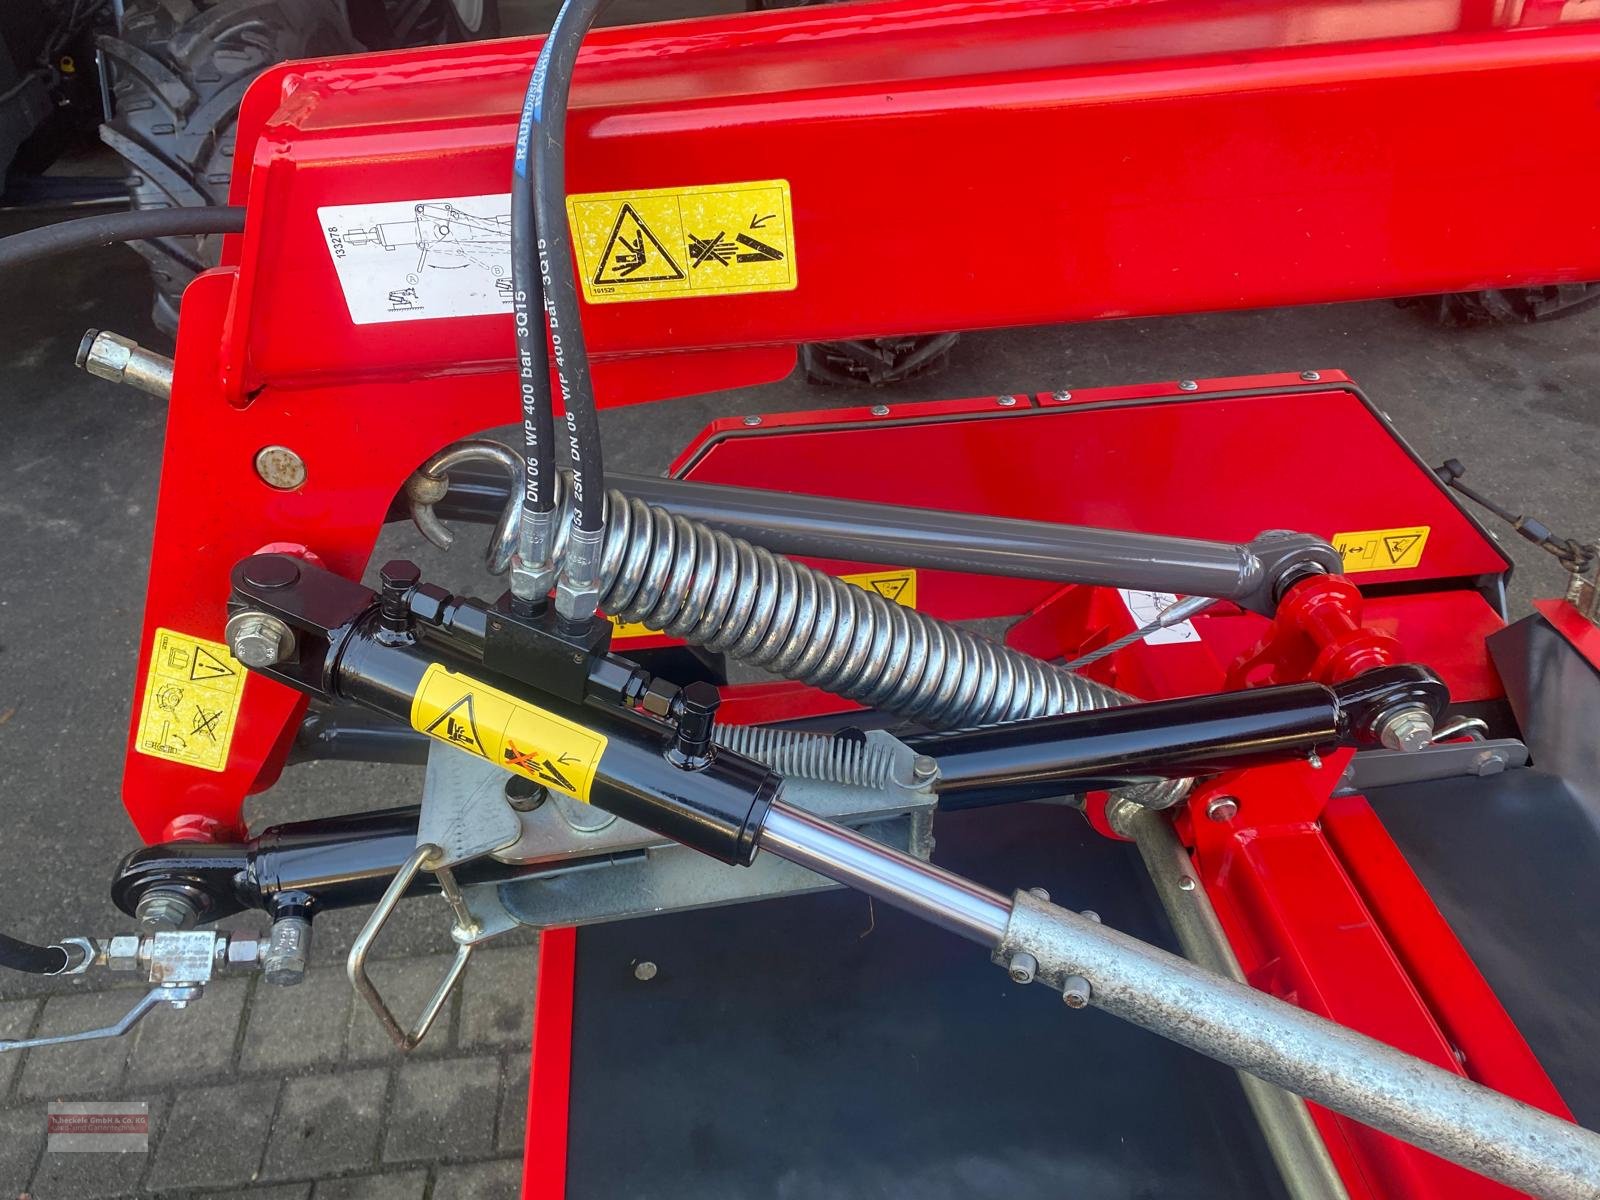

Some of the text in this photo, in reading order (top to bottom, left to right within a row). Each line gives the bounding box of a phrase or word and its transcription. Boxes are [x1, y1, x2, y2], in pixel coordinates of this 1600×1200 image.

[328, 226, 347, 259] 133278
[537, 238, 552, 285] 3Q15
[547, 299, 559, 328] bar
[552, 334, 565, 367] 400
[515, 290, 539, 503] DN 06 WP 400 bar 3Q15
[558, 372, 571, 401] WP
[566, 412, 577, 431] 06
[569, 436, 581, 462] DN
[573, 469, 583, 502] 2SN
